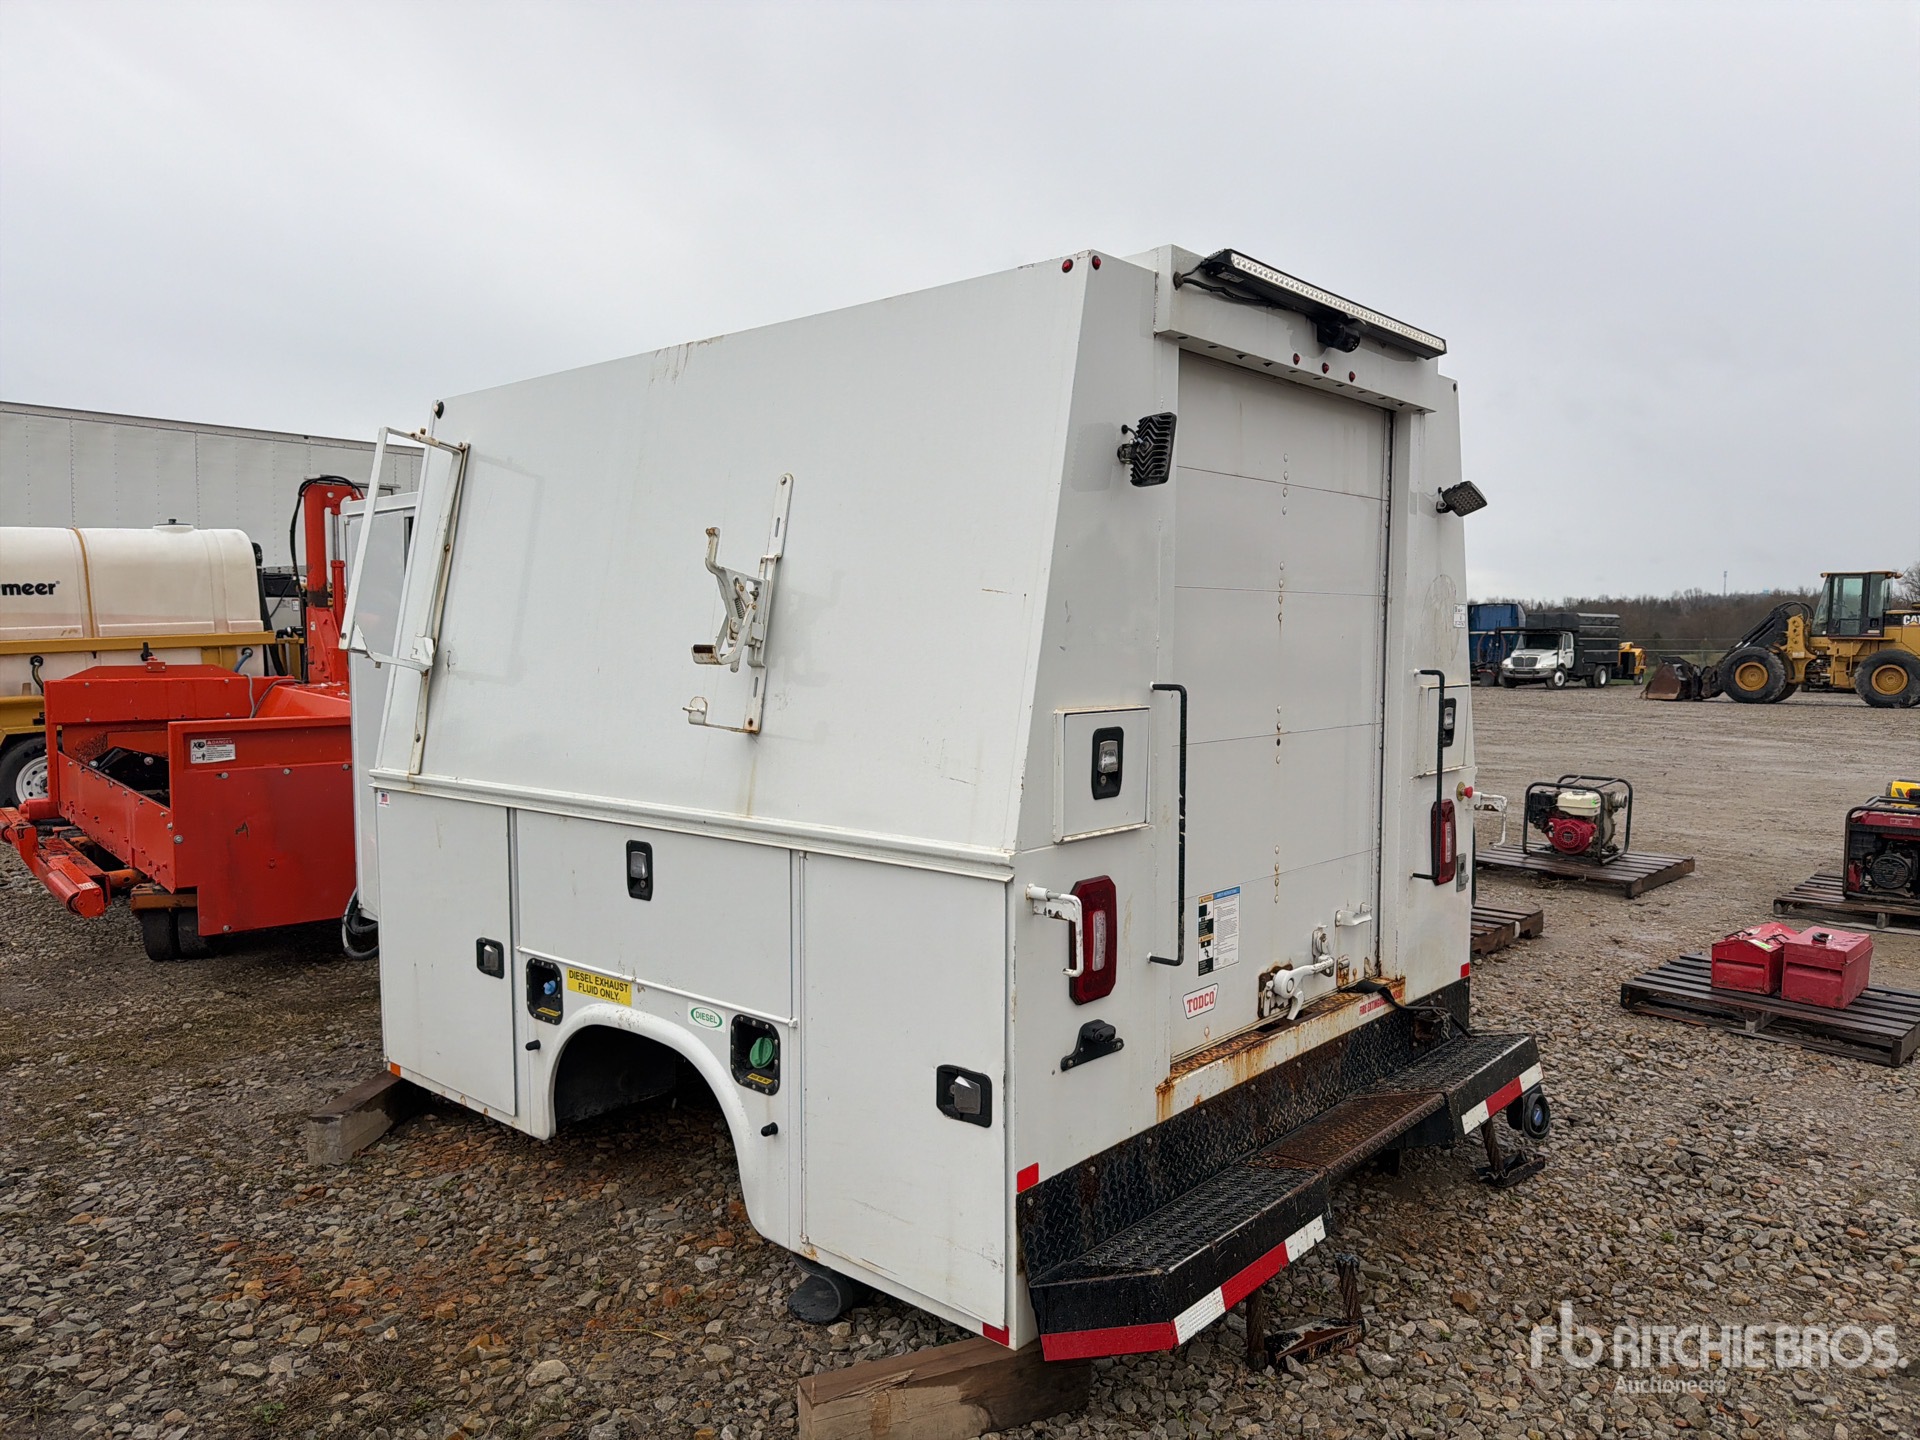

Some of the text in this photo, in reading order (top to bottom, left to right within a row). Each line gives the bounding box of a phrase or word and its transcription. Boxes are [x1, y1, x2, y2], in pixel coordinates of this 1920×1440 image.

[569, 970, 629, 993] DIESEL EXHAUST
[578, 982, 599, 996] FLUID
[1186, 991, 1214, 1013] TODCO
[695, 1010, 718, 1024] DIESEL
